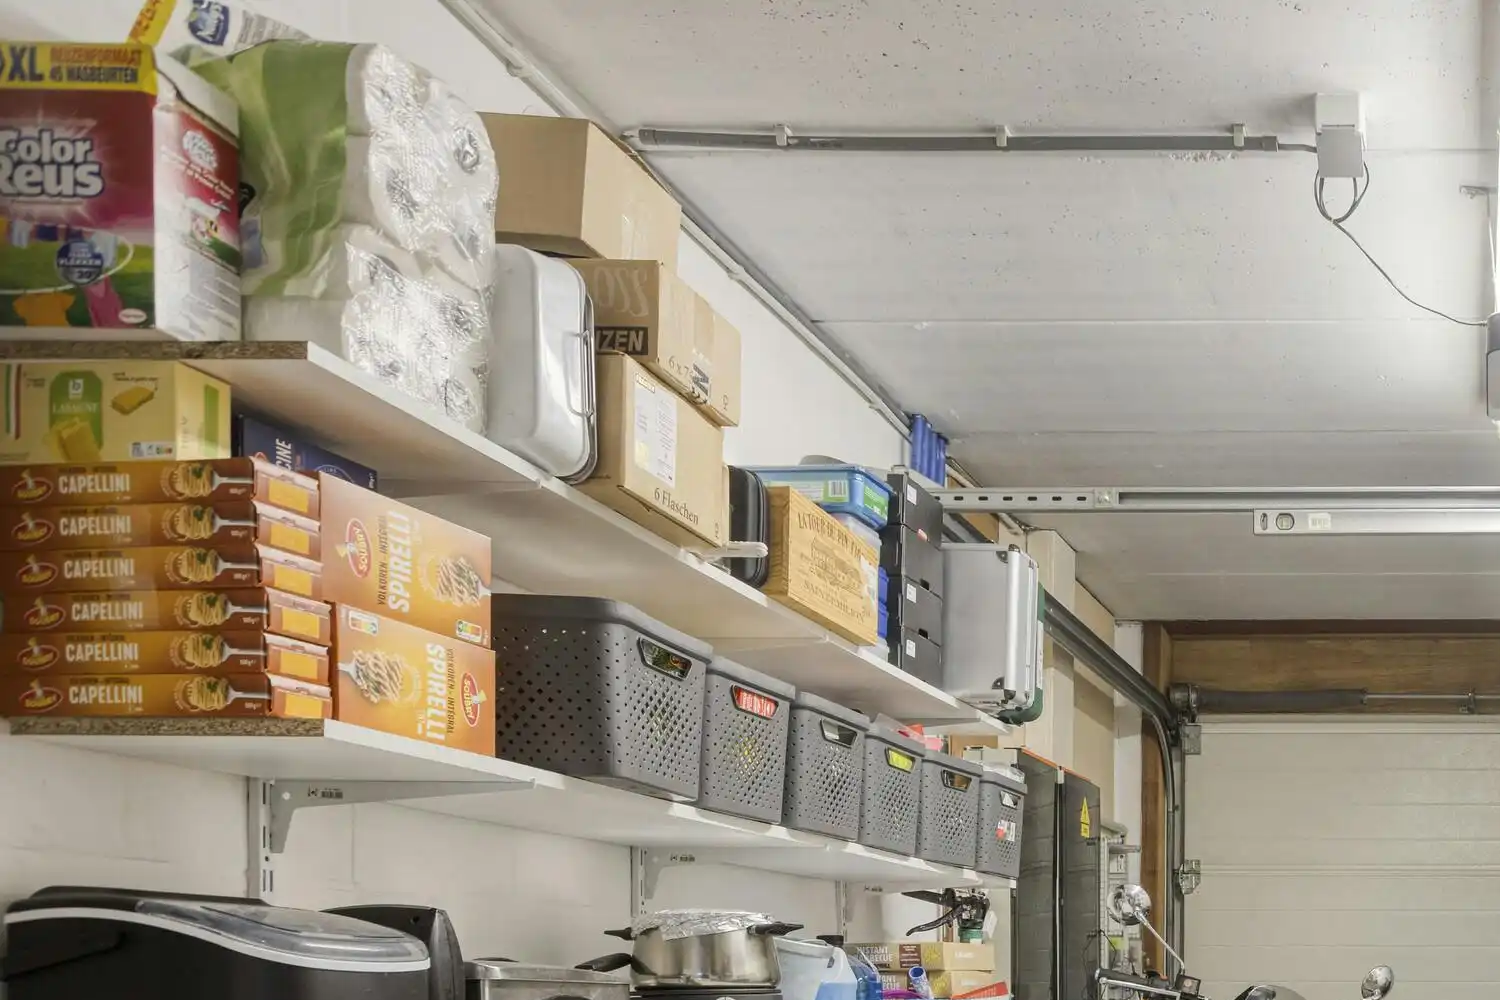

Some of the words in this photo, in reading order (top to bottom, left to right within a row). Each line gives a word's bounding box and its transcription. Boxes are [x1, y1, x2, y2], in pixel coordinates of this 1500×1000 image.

[58, 473, 131, 494] CAPELLINI
[654, 487, 660, 501] 6
[662, 490, 699, 526] Flaschen
[59, 515, 132, 536] CAPELLINI
[63, 558, 136, 579] CAPELLINI
[387, 510, 412, 614] SPIRELLI
[71, 601, 144, 622] CAPELLINI
[65, 643, 139, 663] CAPELLINI
[68, 685, 143, 705] CAPELLINI
[426, 643, 447, 741] SPIRELLI
